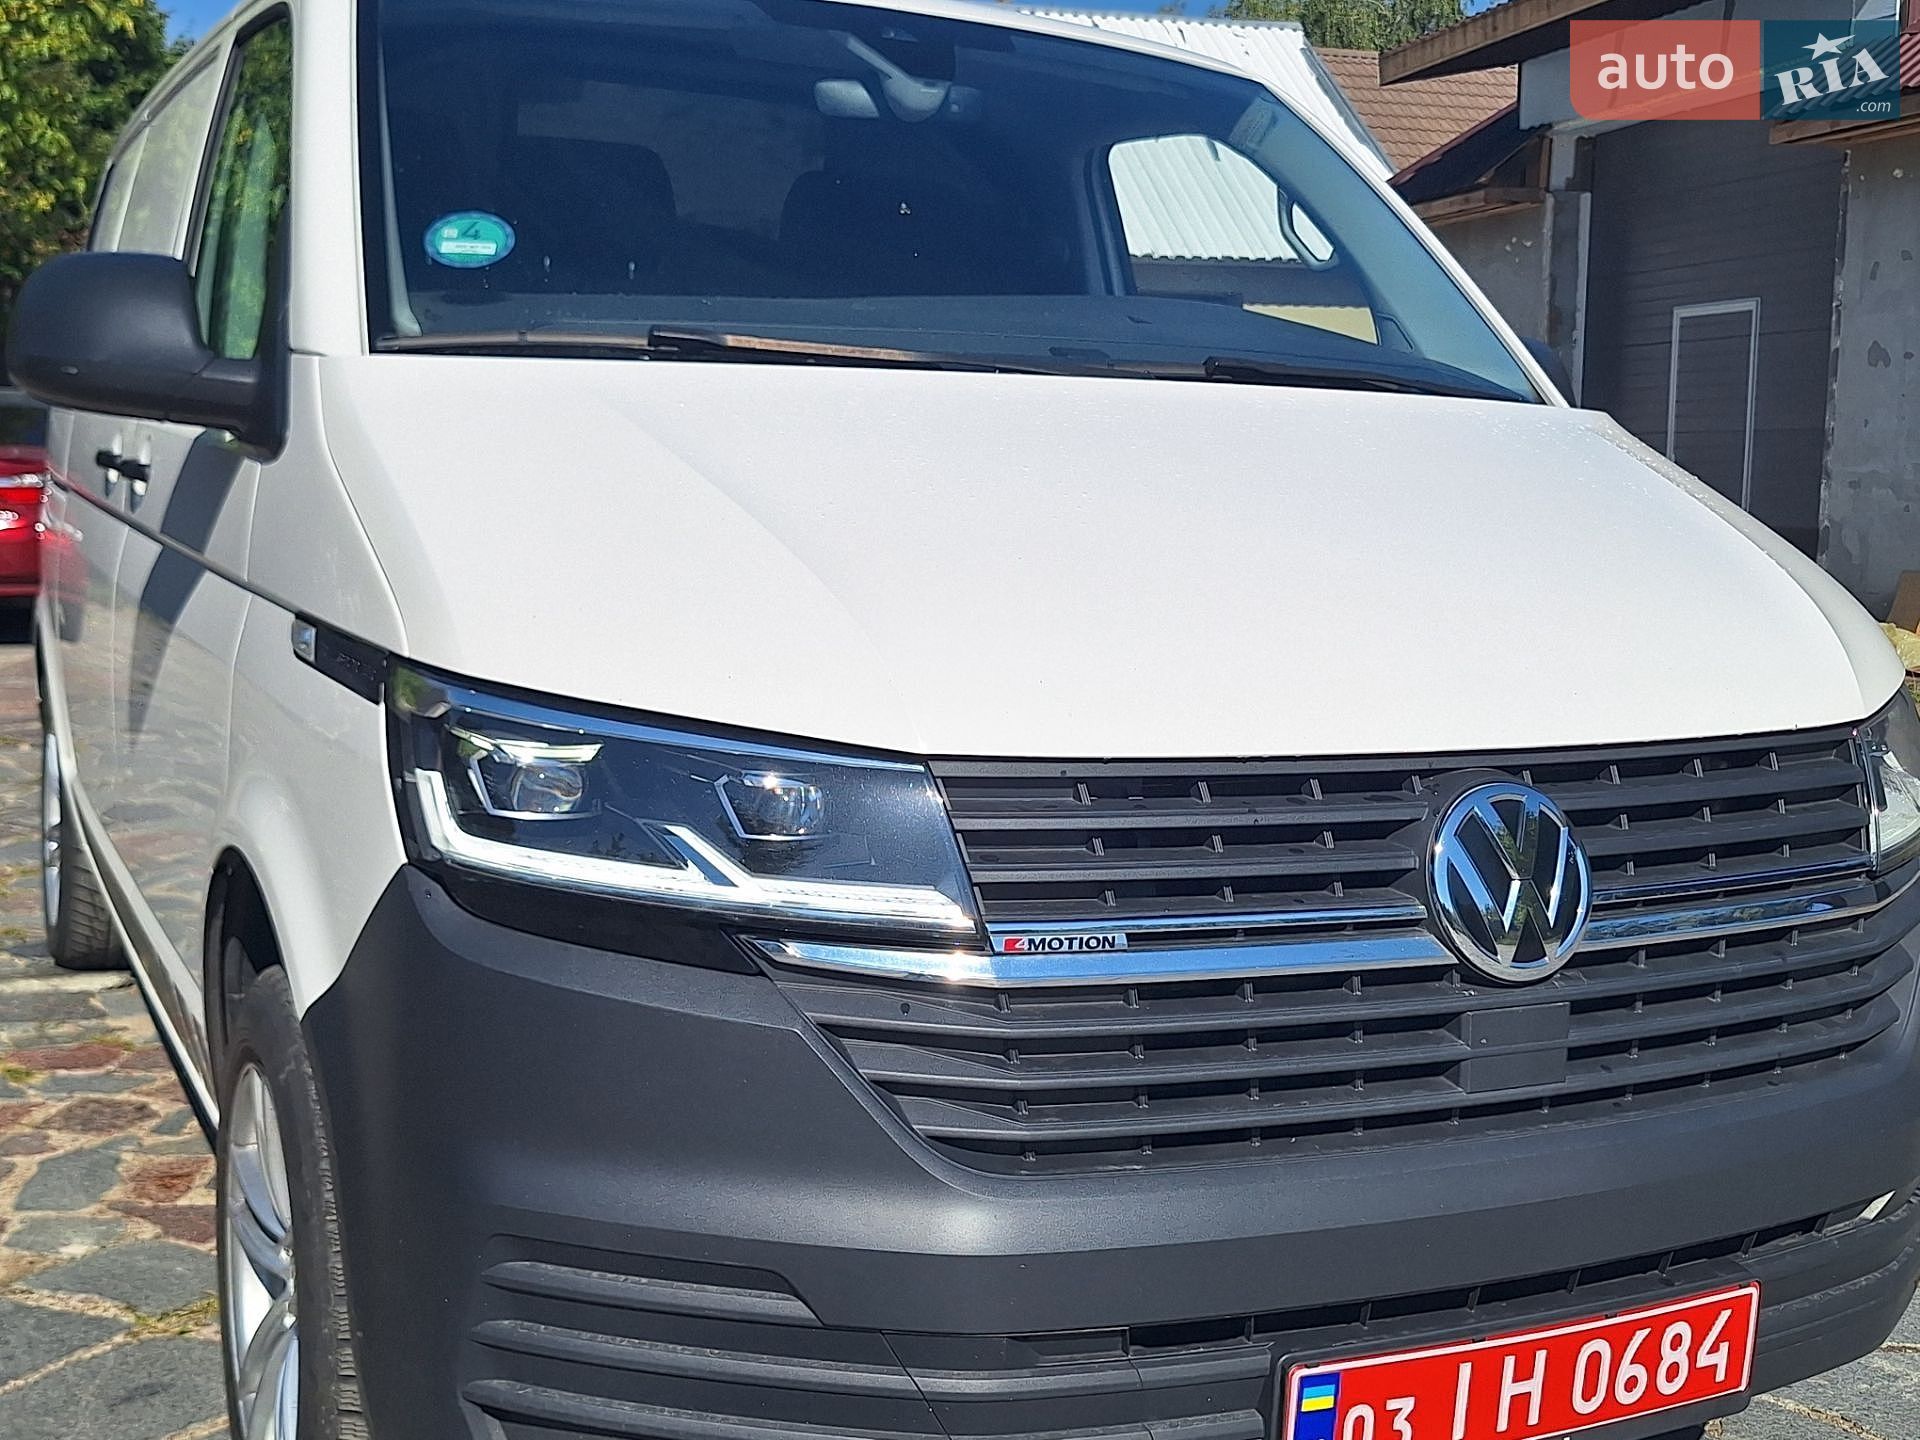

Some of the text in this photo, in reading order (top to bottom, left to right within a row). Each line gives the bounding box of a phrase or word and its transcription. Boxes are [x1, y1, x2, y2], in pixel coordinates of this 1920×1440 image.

[461, 221, 481, 241] 4
[1009, 935, 1116, 952] 4MOTION
[1572, 1309, 1732, 1415] 0684
